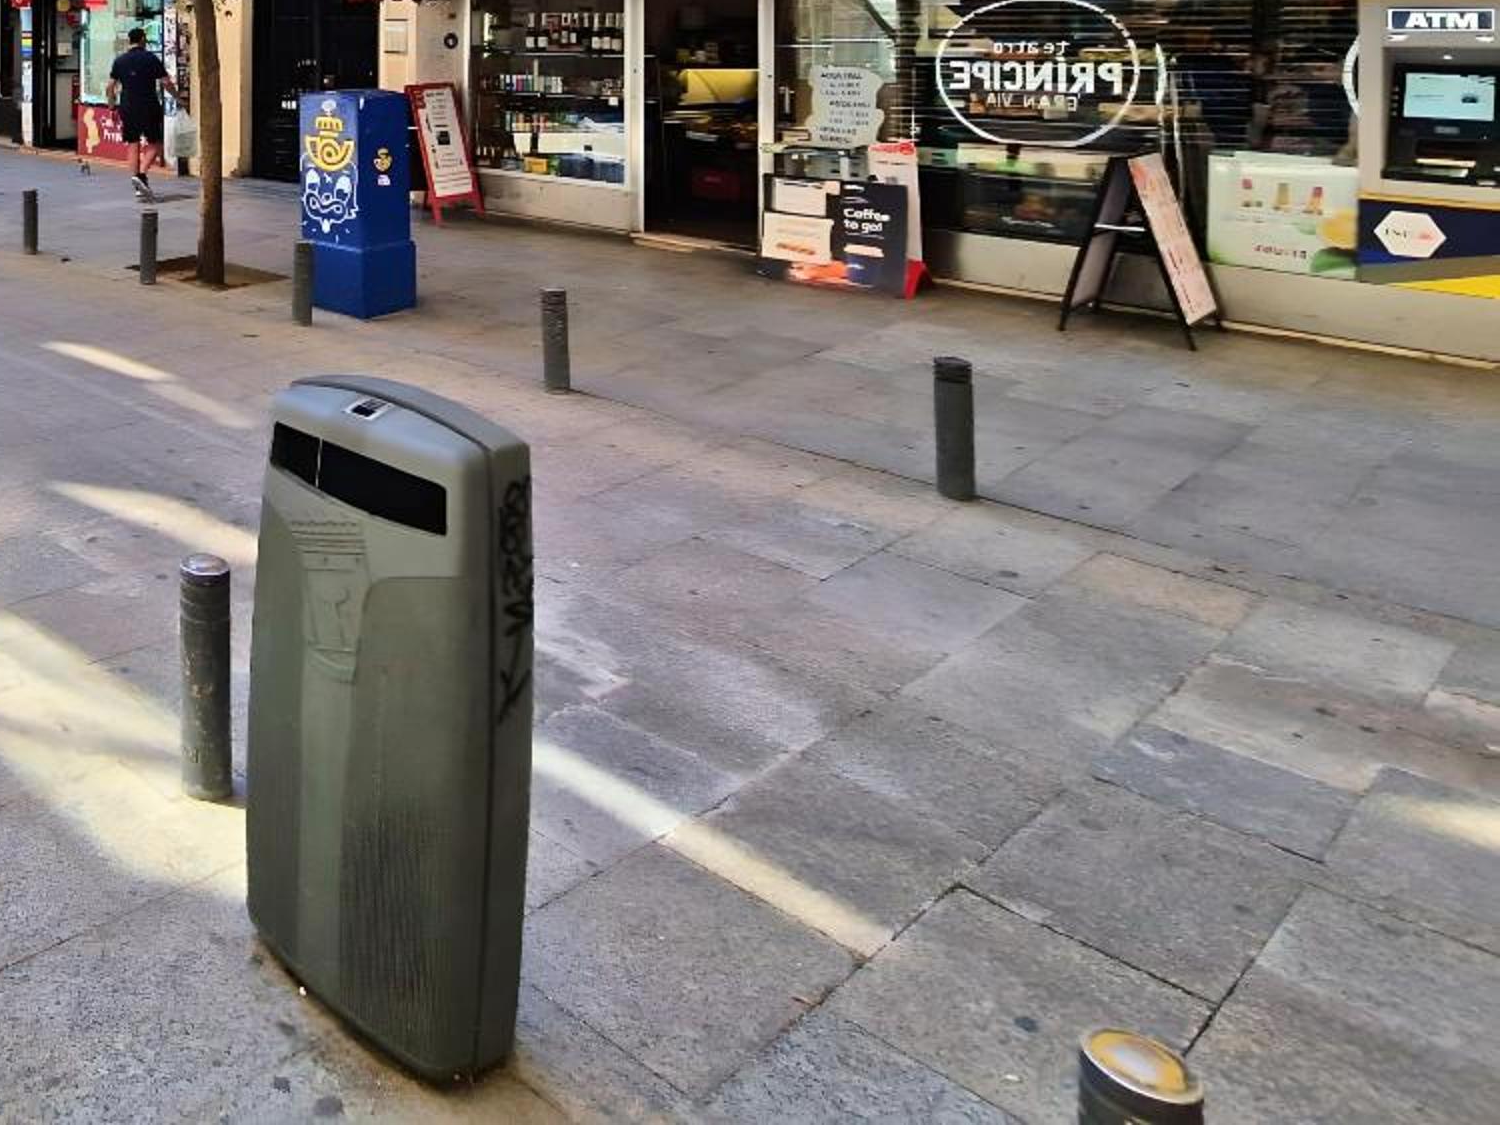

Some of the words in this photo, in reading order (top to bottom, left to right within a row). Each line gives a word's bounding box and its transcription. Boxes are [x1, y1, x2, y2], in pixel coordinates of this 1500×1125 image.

[1404, 11, 1479, 29] ATM
[843, 208, 891, 222] Coffee
[843, 219, 858, 230] to
